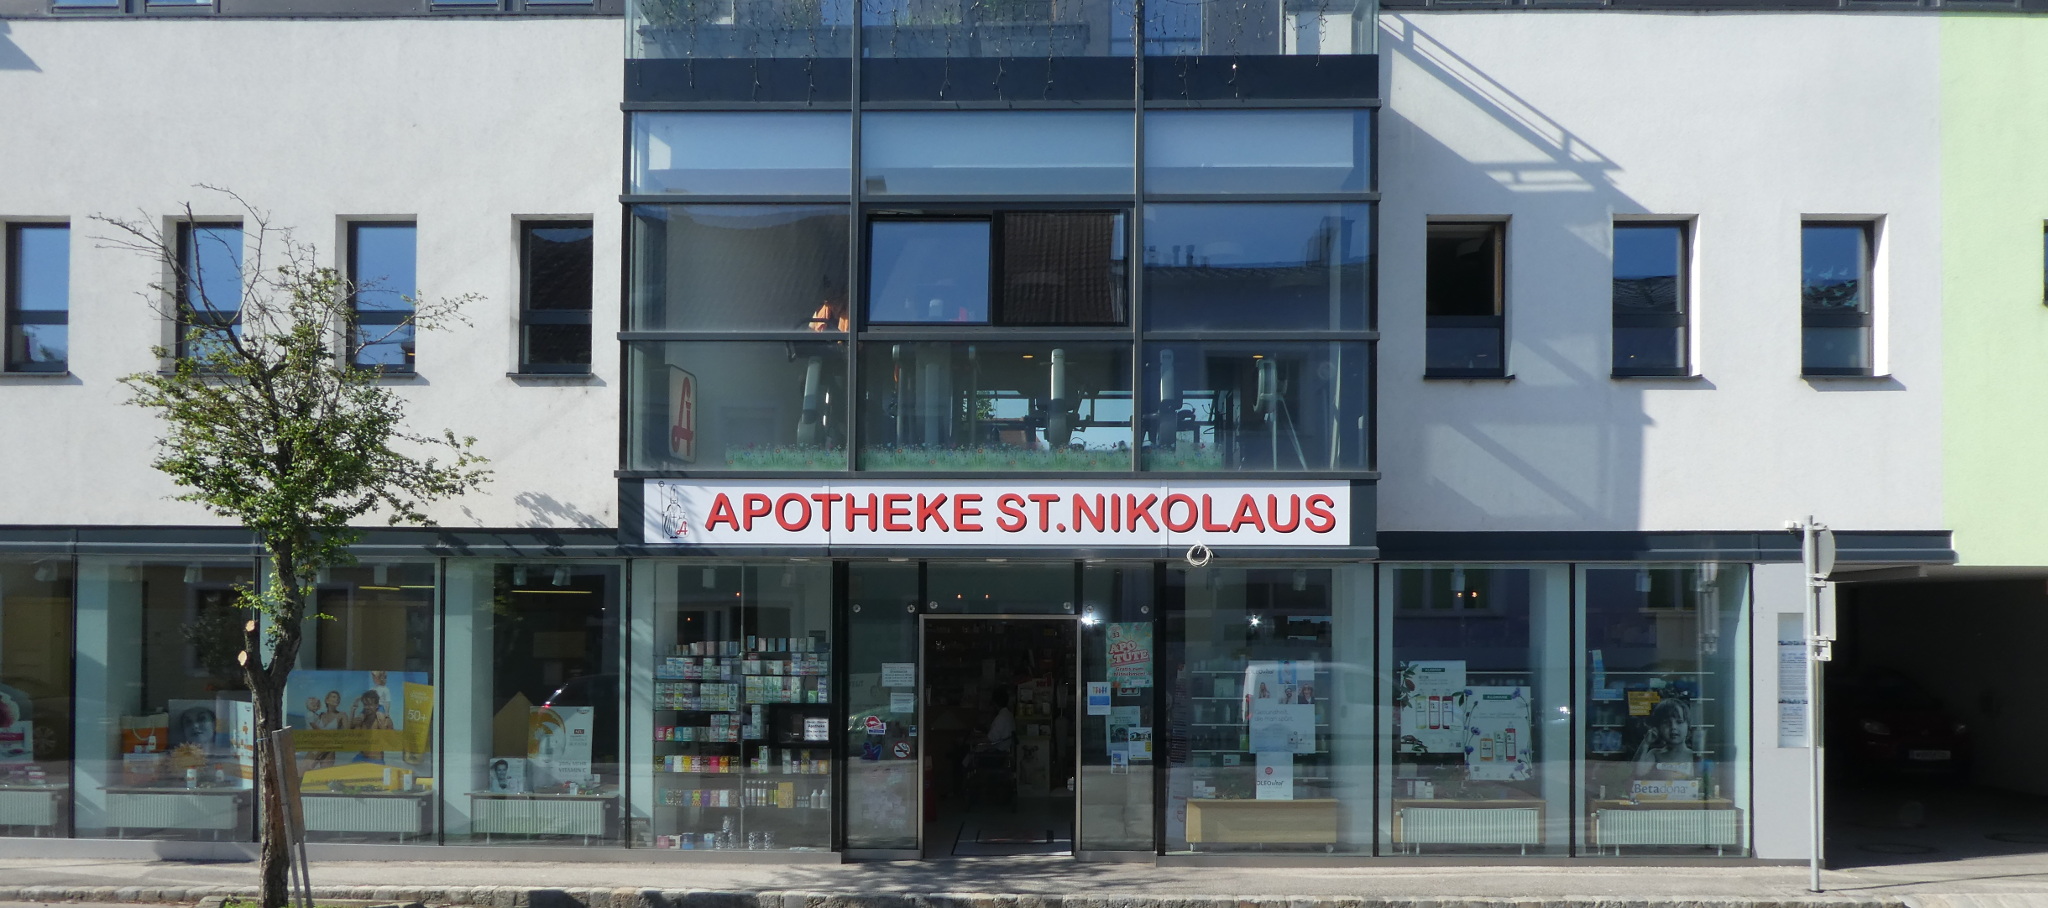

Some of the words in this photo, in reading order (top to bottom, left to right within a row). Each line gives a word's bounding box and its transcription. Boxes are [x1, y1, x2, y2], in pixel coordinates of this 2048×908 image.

[704, 492, 984, 534] APOTHEKE
[995, 492, 1337, 535] ST.NIKOLAUS
[1109, 640, 1137, 654] APO
[407, 709, 427, 721] 50+
[1634, 783, 1687, 794] Betadona
